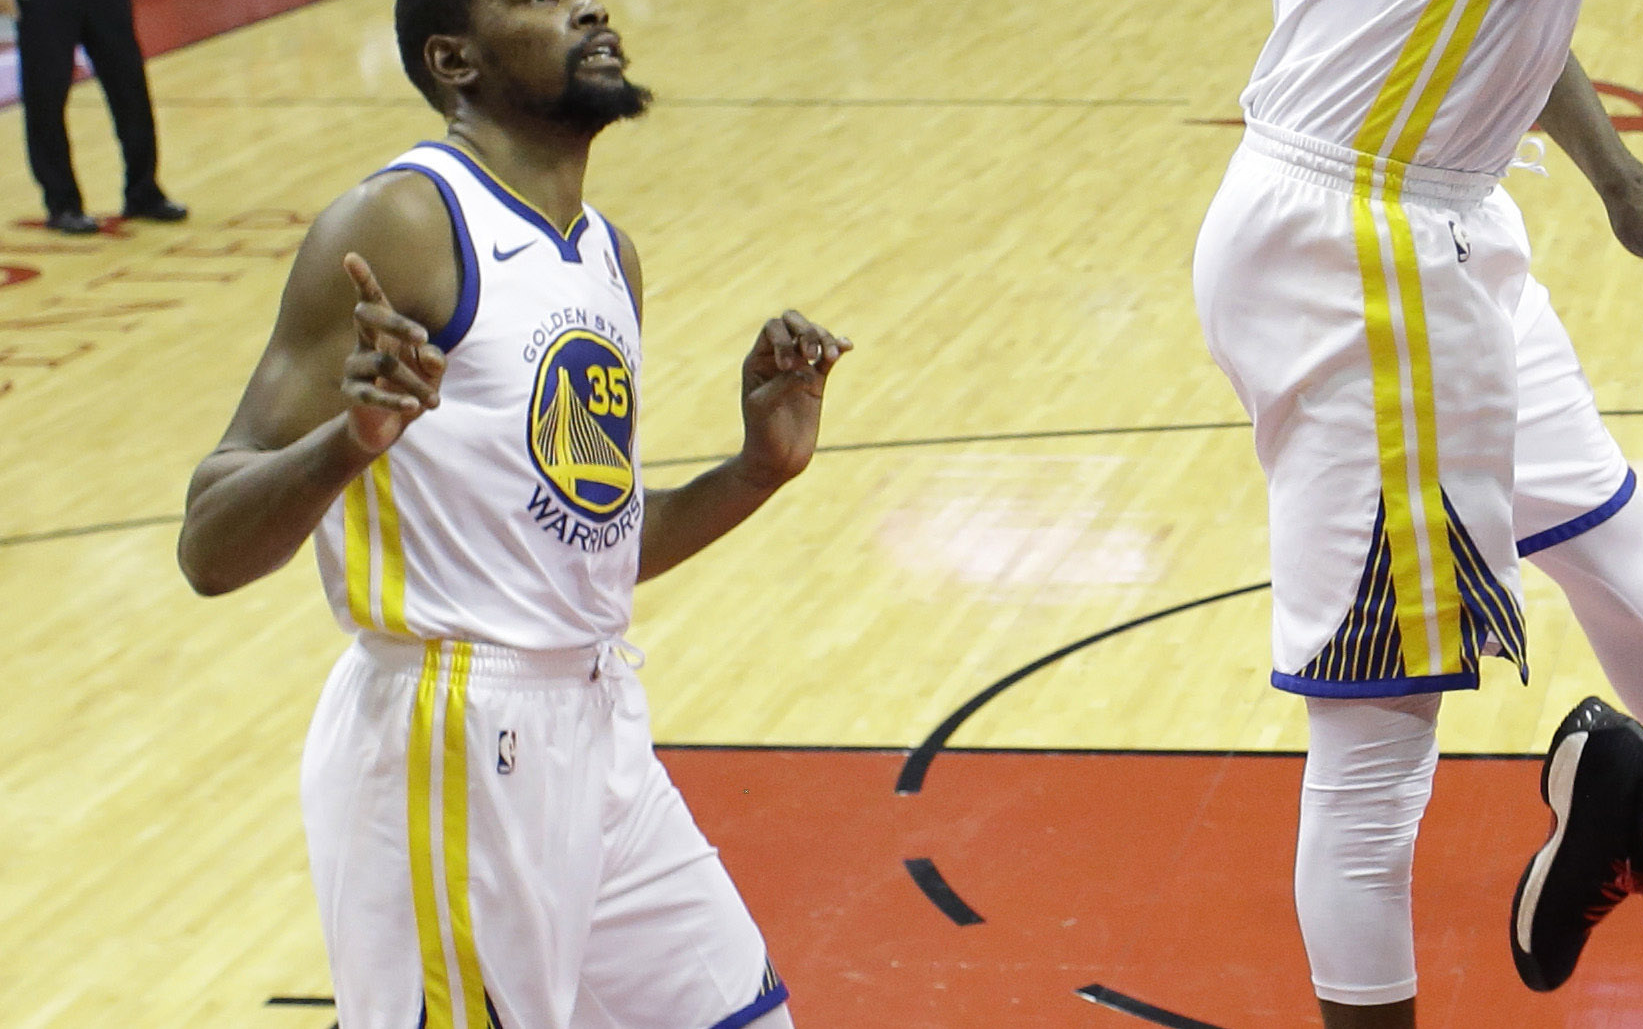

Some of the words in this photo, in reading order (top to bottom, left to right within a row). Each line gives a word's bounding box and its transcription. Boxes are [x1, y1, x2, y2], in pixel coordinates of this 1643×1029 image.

[523, 308, 588, 364] GOLDEN
[586, 365, 628, 418] 35
[527, 484, 642, 553] WARRIORS
